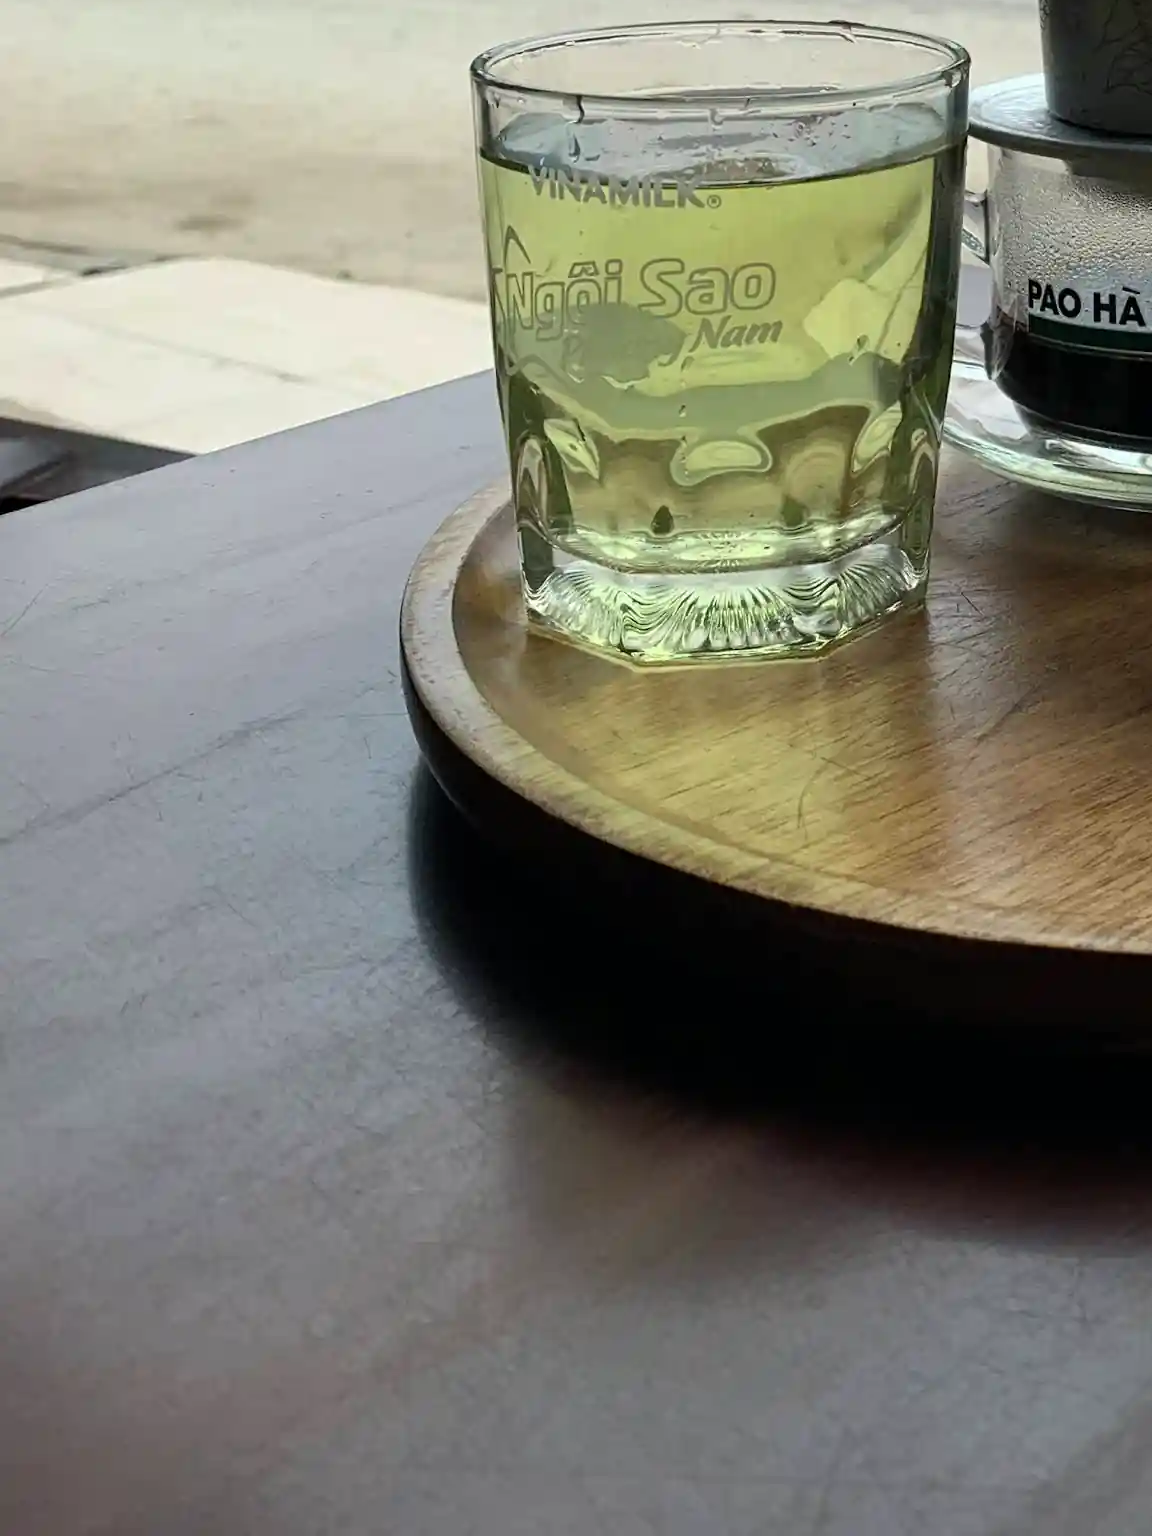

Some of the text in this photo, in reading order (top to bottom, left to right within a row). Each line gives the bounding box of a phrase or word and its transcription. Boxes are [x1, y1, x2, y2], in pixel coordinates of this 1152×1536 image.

[506, 258, 776, 341] Ngôi Sao
[1027, 279, 1081, 318] PAO
[1093, 286, 1146, 327] HÀ
[689, 315, 783, 353] Nam
